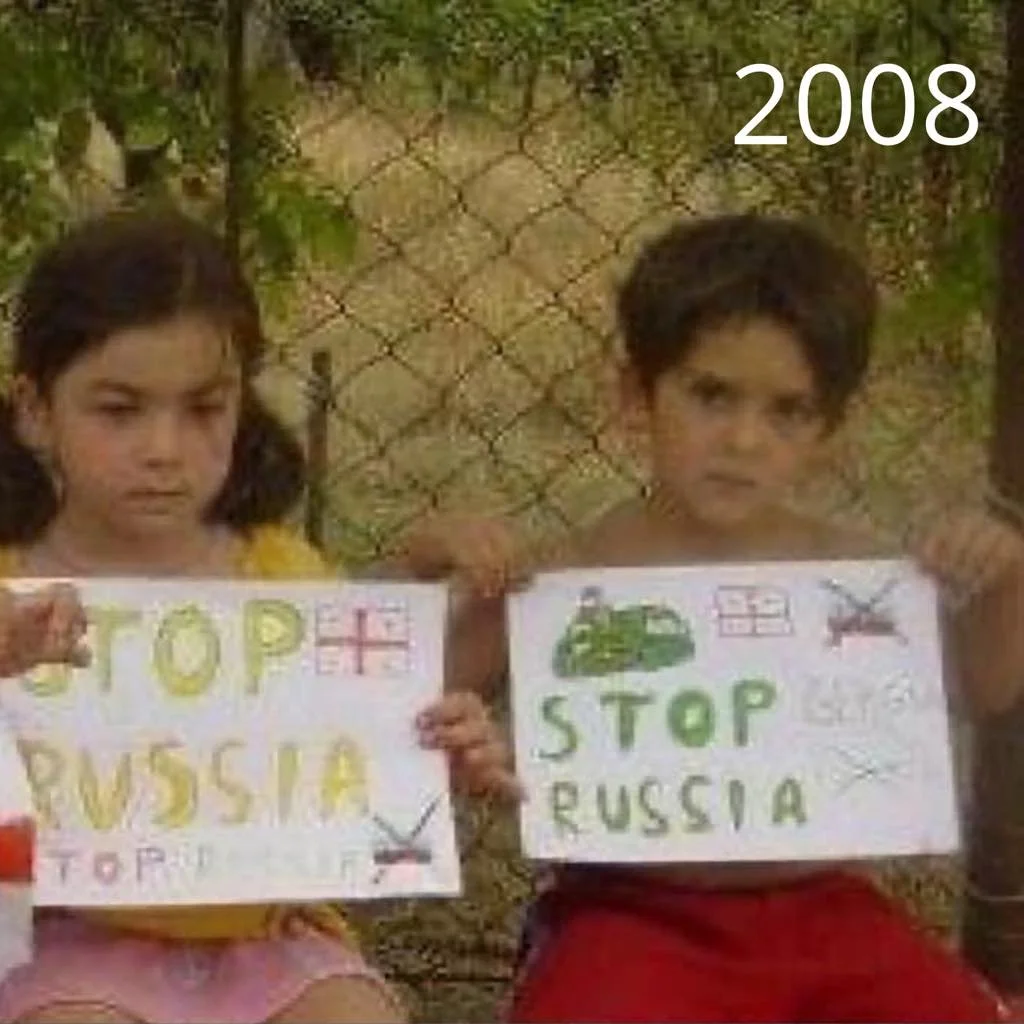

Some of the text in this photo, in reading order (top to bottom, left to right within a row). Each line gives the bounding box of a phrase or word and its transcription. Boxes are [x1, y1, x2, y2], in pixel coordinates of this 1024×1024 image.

[530, 679, 778, 762] STOP
[16, 734, 372, 830] RUSSIA
[551, 774, 809, 839] RUSSIA
[42, 844, 166, 886] TOP
